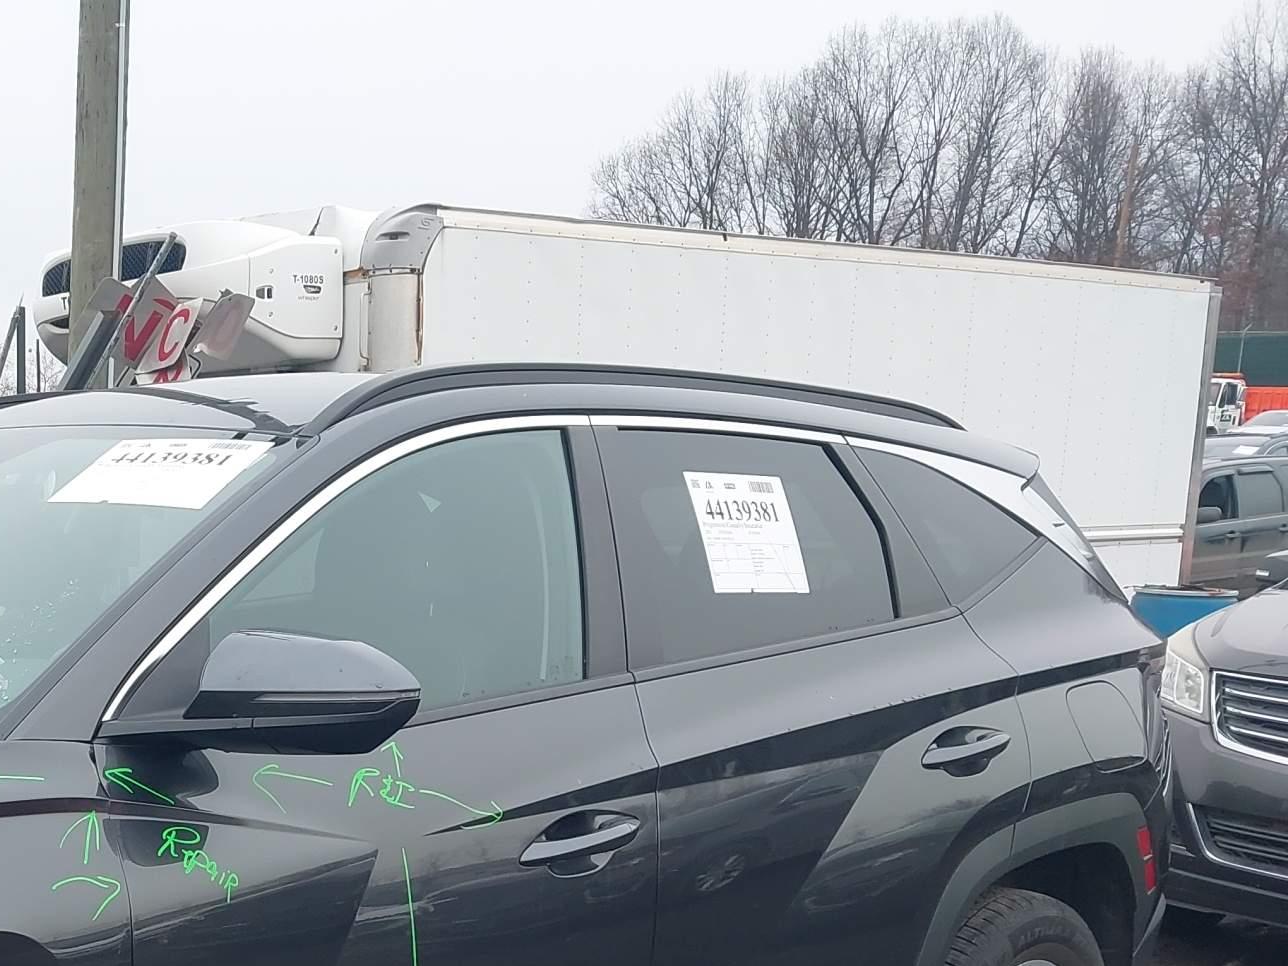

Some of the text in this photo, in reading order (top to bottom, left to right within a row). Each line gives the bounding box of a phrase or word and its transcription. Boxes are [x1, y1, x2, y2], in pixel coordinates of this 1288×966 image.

[293, 274, 323, 285] T-1080S
[158, 308, 190, 362] C
[112, 451, 232, 466] 44139381
[705, 499, 780, 522] 44139381
